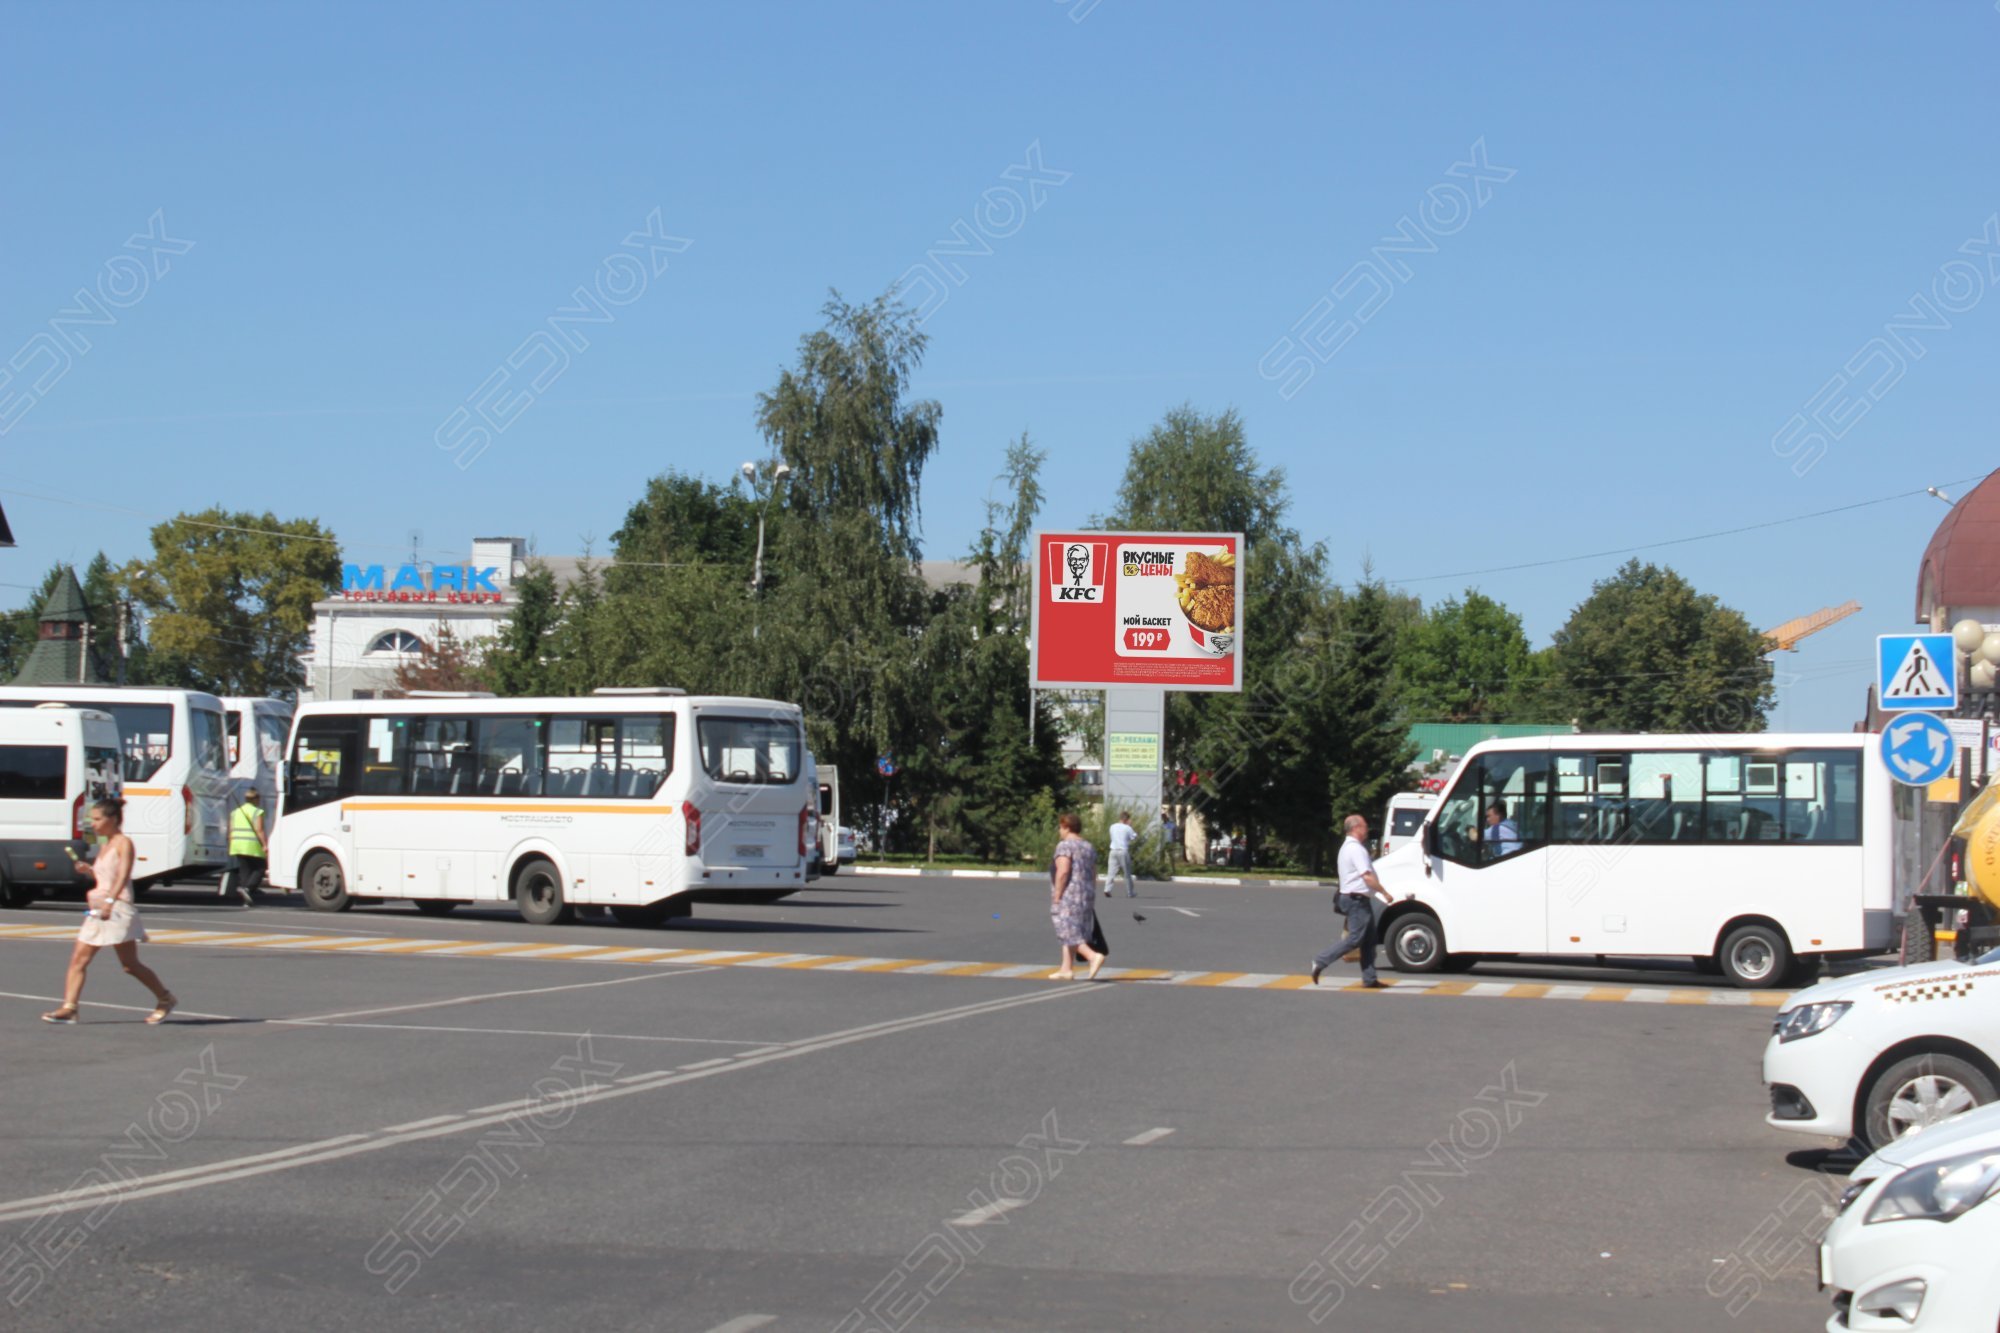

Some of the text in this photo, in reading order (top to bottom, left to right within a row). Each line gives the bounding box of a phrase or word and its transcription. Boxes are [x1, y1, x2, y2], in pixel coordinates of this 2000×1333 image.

[1123, 551, 1174, 565] ВКУСНЫЕ
[1140, 564, 1173, 577] ЦЕНЫ
[342, 564, 502, 592] МАЯК
[1059, 587, 1096, 600] KFC
[1123, 614, 1172, 627] МОЙ БАСКЕТ
[1132, 632, 1155, 647] 199
